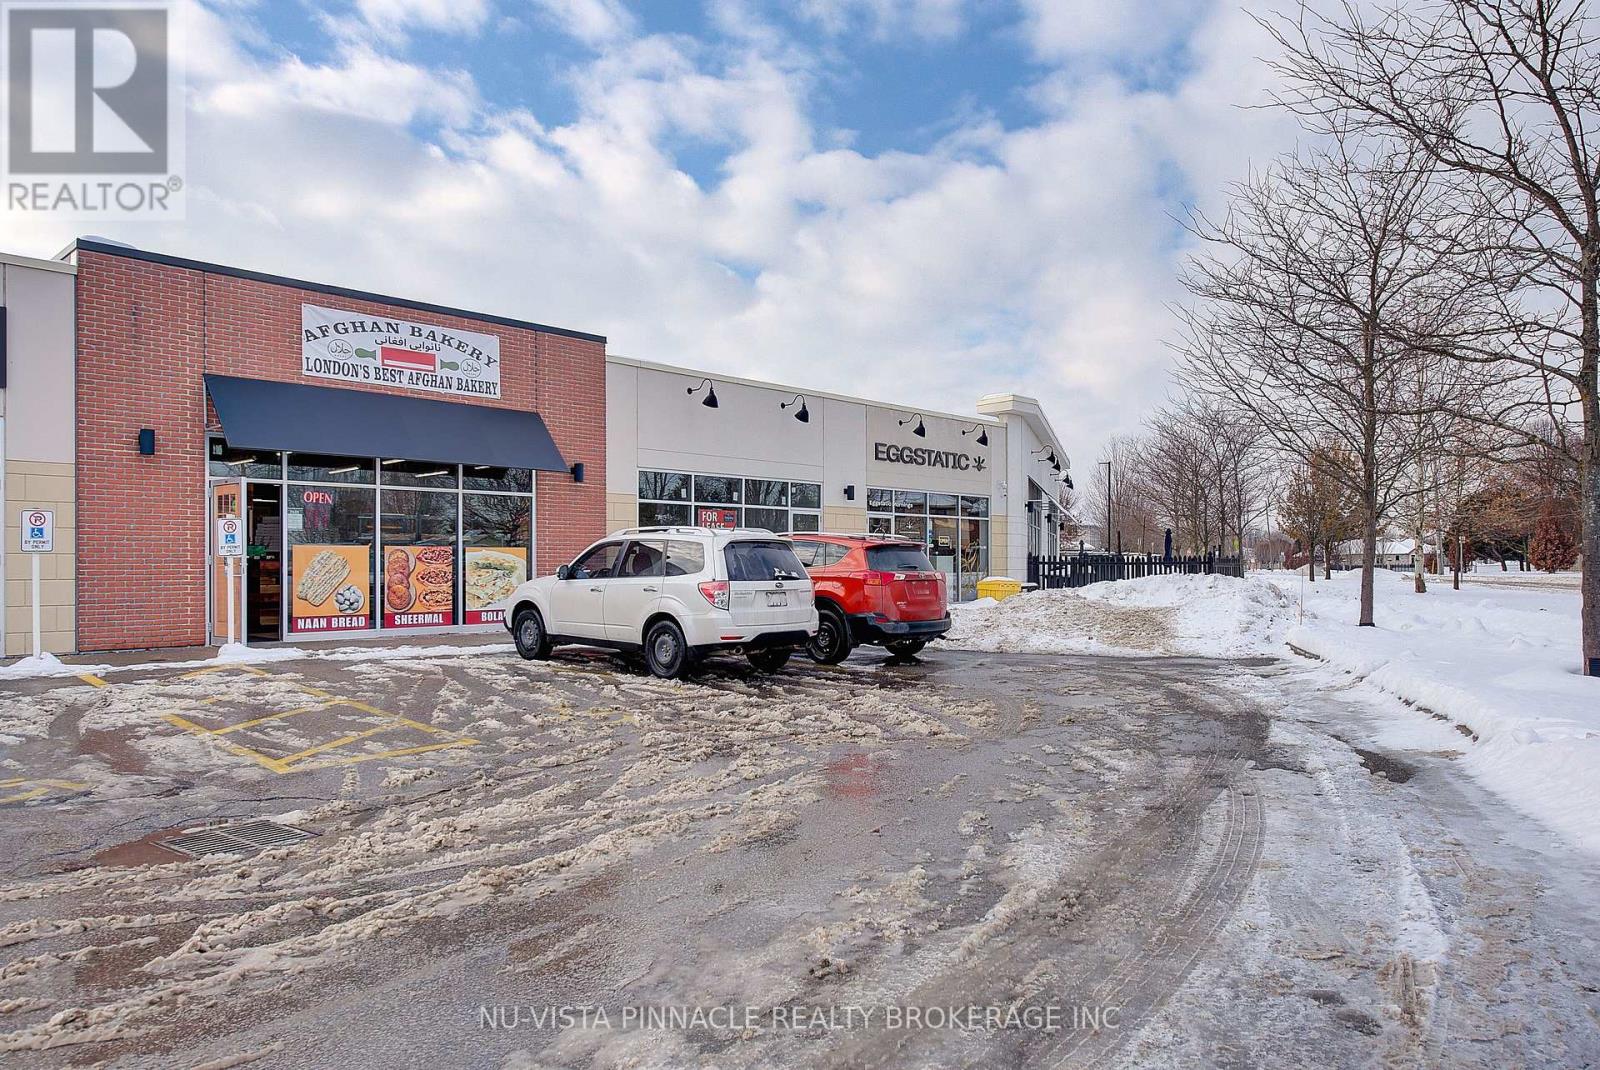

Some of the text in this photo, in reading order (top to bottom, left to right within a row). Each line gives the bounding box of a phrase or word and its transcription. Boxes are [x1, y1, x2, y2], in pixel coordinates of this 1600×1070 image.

[303, 320, 498, 368] AFGHAN BAKERY
[305, 356, 498, 396] LONDON'S BEST AFGHAN BAKERY
[874, 442, 970, 471] EGGSTATIC
[303, 491, 333, 504] OPEN
[702, 511, 718, 522] FOR
[297, 616, 366, 629] NAAN BREAD
[394, 612, 444, 625] SHEERMAL
[481, 611, 506, 621] BOLA
